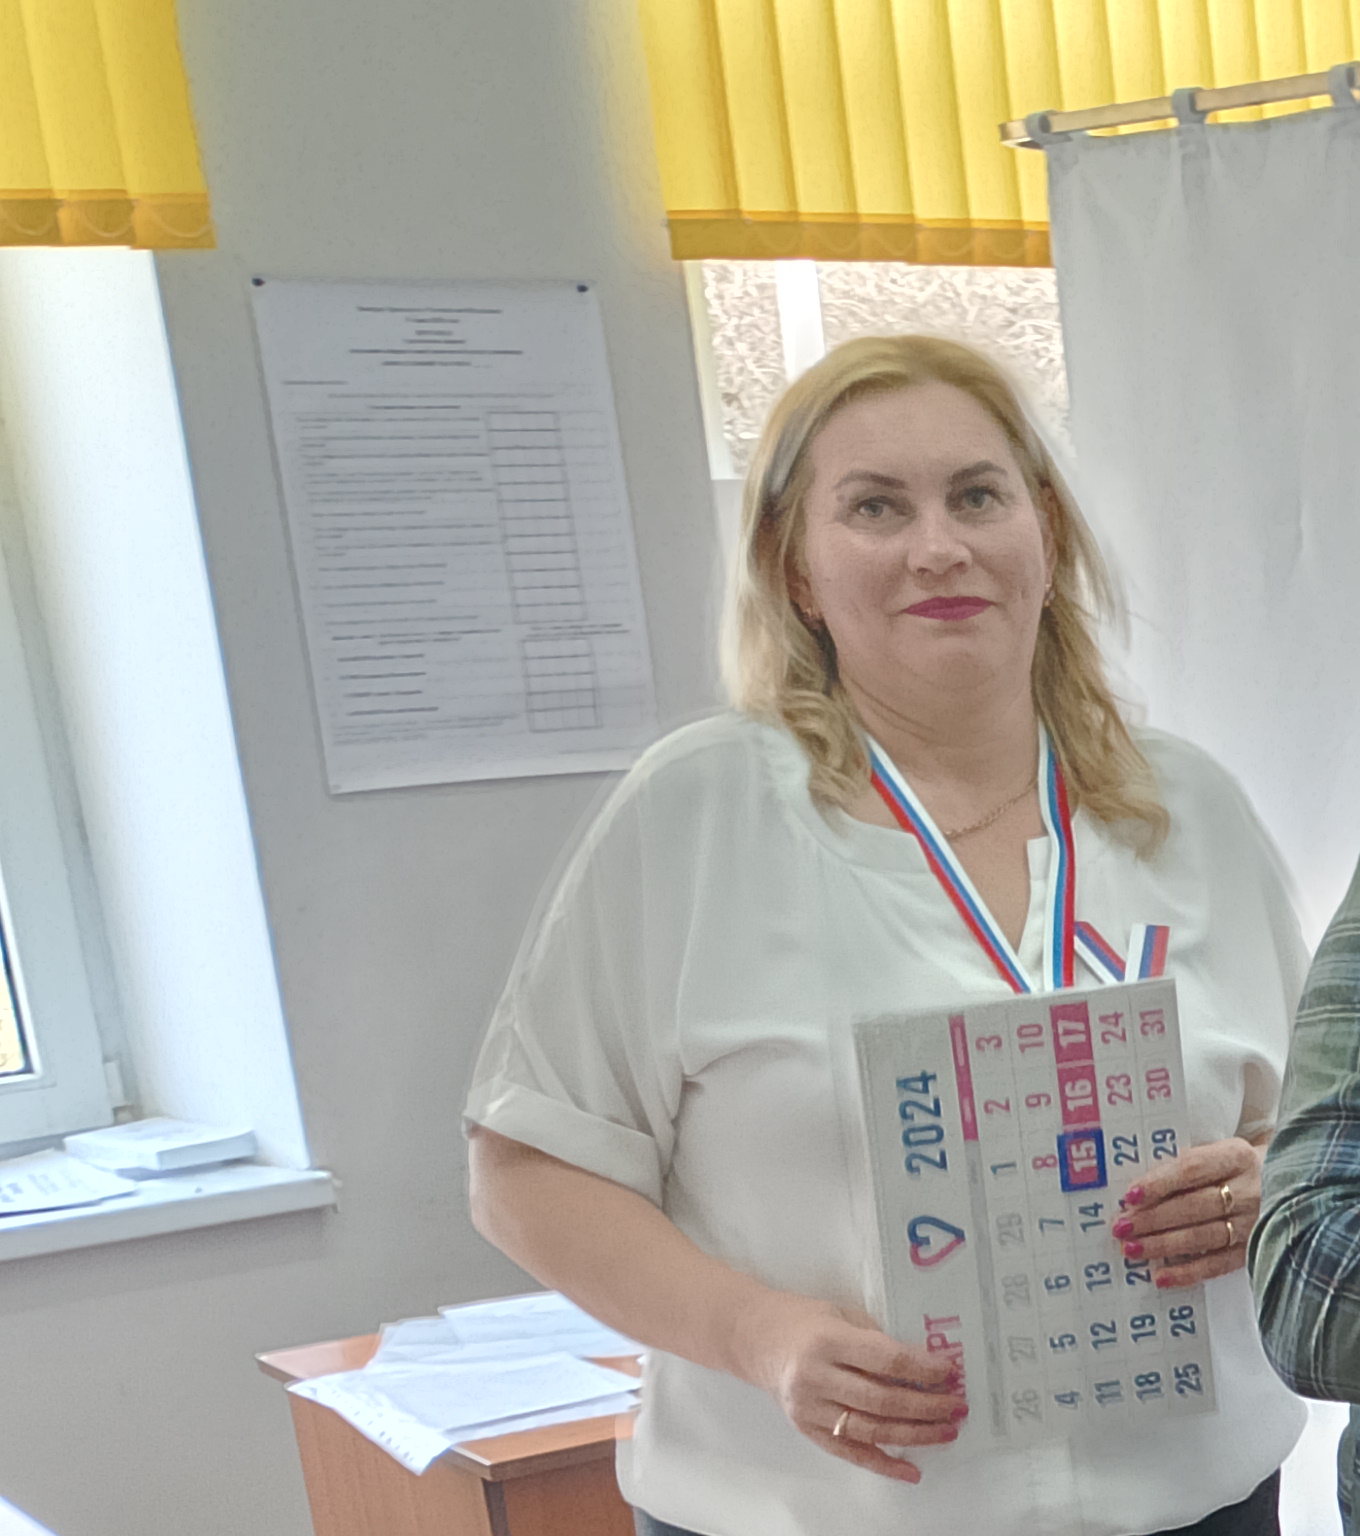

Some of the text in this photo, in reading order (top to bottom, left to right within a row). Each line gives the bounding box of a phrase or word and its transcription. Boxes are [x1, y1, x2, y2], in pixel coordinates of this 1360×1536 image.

[976, 1035, 1003, 1052] 3
[1101, 1011, 1127, 1044] 24
[1107, 1073, 1134, 1107] 23
[896, 1070, 948, 1175] 2024
[984, 1098, 1011, 1116] 2
[1114, 1134, 1141, 1166] 22
[991, 1161, 1017, 1175] 1
[1017, 1023, 1081, 1408] 4 5 6 7 8 9 10
[1059, 1020, 1123, 1409] 11 12 13 14 15 16 17
[1141, 1008, 1203, 1395] 25 26 29 30 31
[1002, 1273, 1035, 1307] 28
[1131, 1313, 1157, 1343] 19
[1007, 1336, 1037, 1365] 27
[1136, 1371, 1162, 1404] 18
[1009, 1388, 1040, 1423] 26
